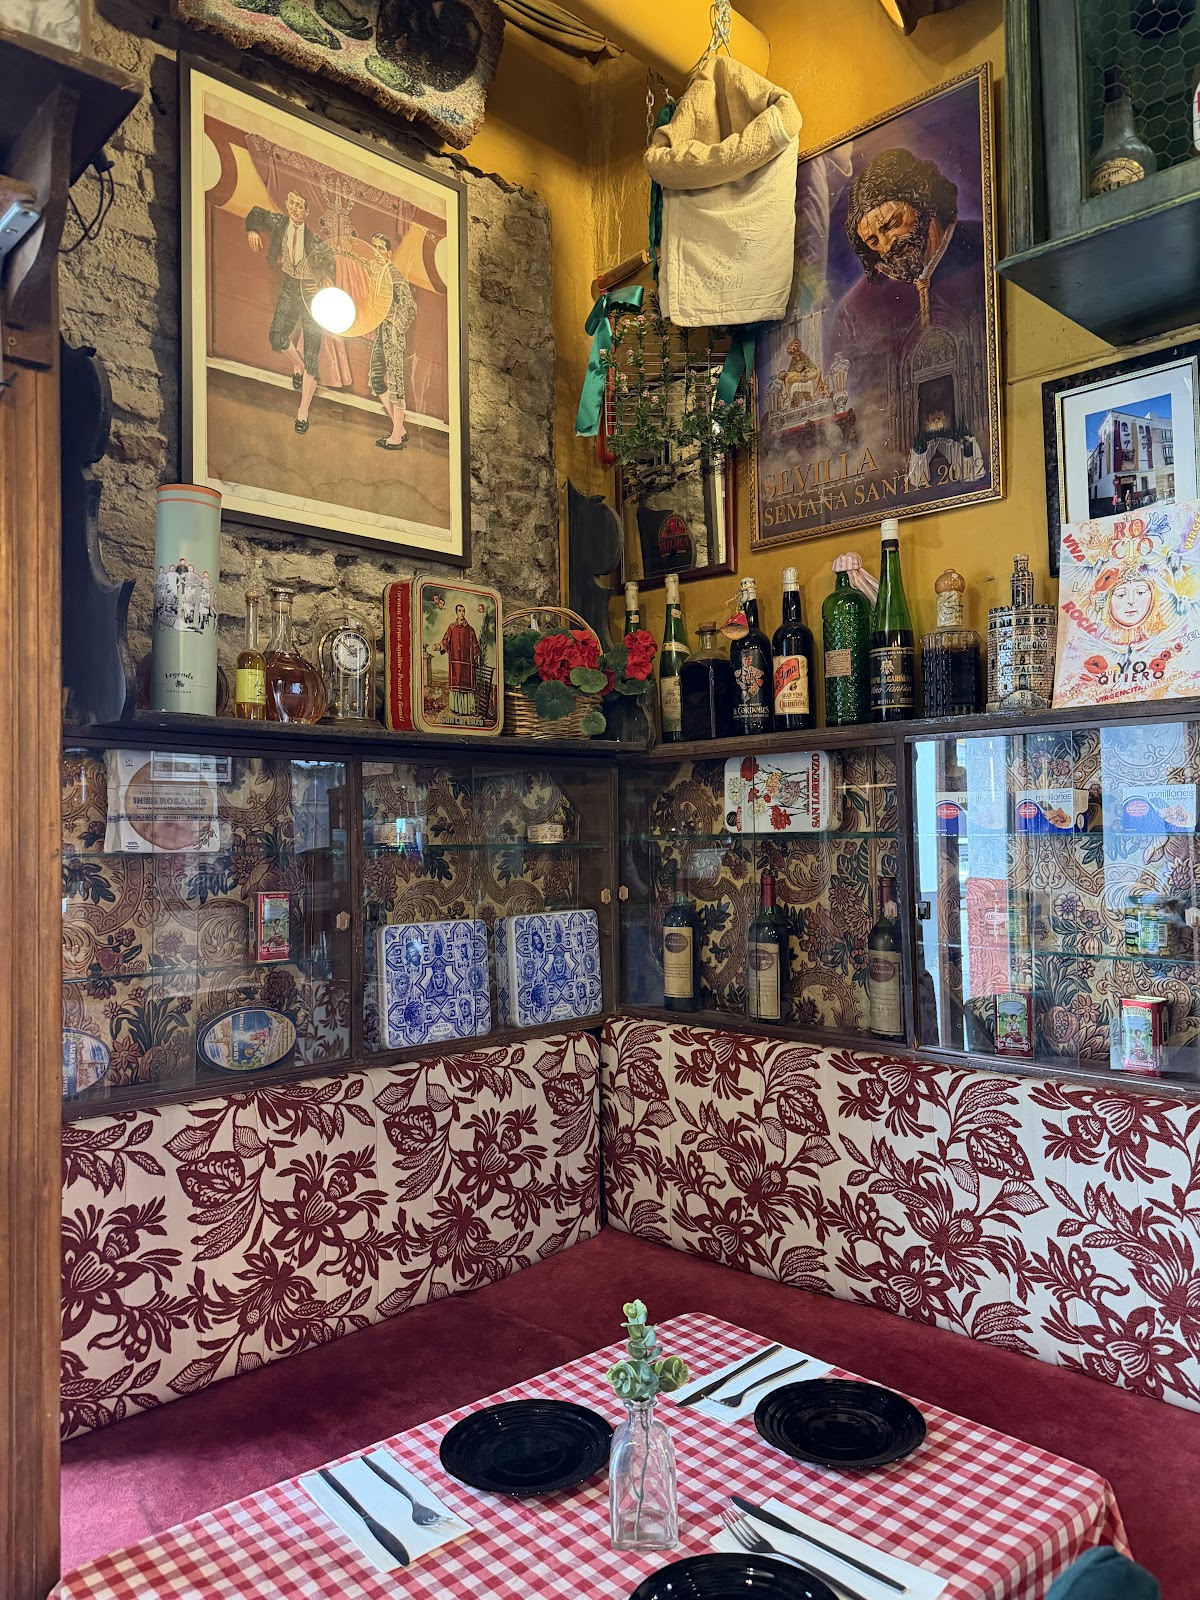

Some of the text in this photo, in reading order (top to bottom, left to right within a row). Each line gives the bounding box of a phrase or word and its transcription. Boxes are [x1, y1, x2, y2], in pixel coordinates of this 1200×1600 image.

[763, 447, 879, 499] SEVILLA
[764, 489, 849, 527] SEMANA
[854, 471, 932, 505] SANTA
[937, 457, 987, 486] 2012
[1113, 519, 1145, 540] RO
[1063, 533, 1086, 562] VIVA
[1072, 580, 1090, 592] LA
[1032, 641, 1047, 649] ORO
[1117, 661, 1147, 674] YO
[165, 672, 194, 680] Legends
[1098, 671, 1164, 685] QUIERO
[1095, 685, 1144, 703] VIRGENCITA
[455, 716, 484, 726] Lorenzo
[812, 753, 820, 828] SAN LORENZO
[1148, 789, 1194, 798] mejillones
